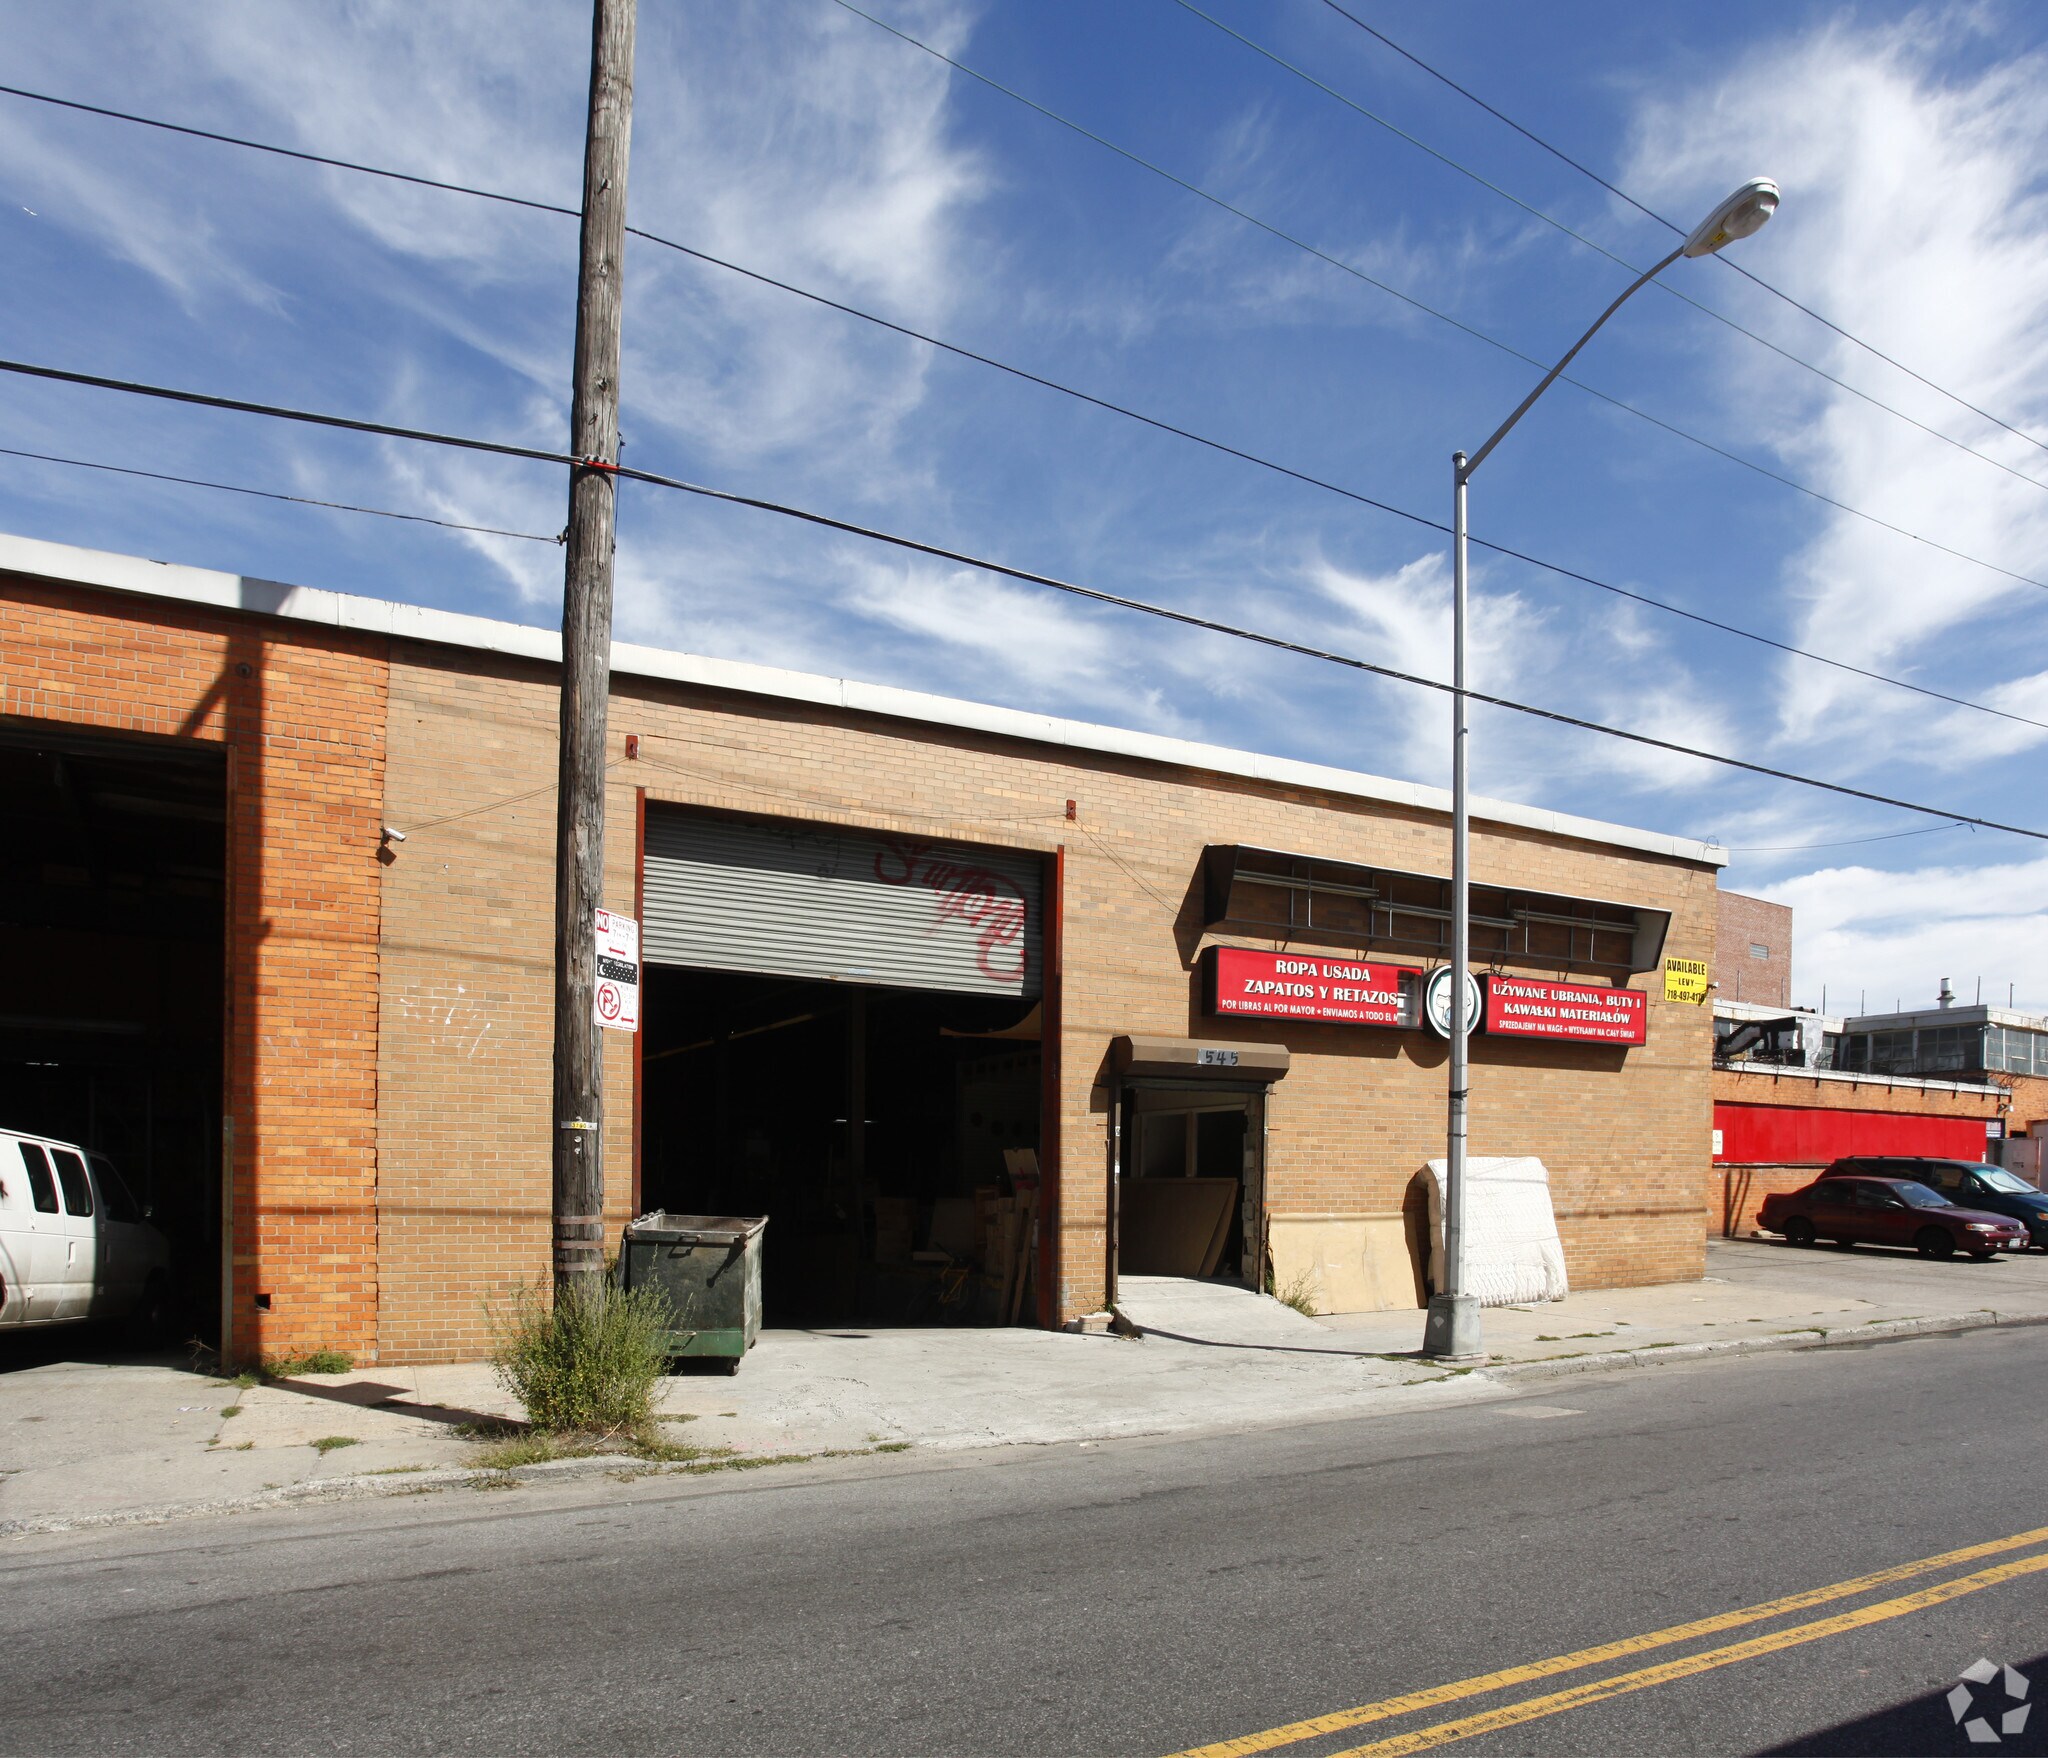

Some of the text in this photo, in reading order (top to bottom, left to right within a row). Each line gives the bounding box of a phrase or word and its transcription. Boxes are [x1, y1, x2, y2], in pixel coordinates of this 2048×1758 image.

[597, 912, 609, 931] NO
[1276, 959, 1372, 982] ROPA USADA
[1667, 959, 1706, 976] AVAILABLE
[1678, 977, 1695, 987] LEVY
[1243, 979, 1398, 1006] ZAPATOS Y RETAZOS
[1492, 980, 1641, 1009] UŻYWANE UBRANIA, BUTY I
[1667, 989, 1706, 1003] 718-497-417
[1221, 999, 1237, 1010] POR
[1238, 1000, 1262, 1012] LIBRAS
[1263, 1002, 1272, 1013] AL
[1273, 1003, 1288, 1014] POR
[1289, 1005, 1316, 1016] MAYOR
[1322, 1007, 1358, 1019] ENVIAMOS
[1359, 1010, 1365, 1020] A
[1365, 1011, 1384, 1021] TODO
[1385, 1013, 1392, 1022] EL
[1503, 1002, 1631, 1025] KAWAŁKI MATERIAŁÓW
[1498, 1019, 1537, 1031] SPRZEDAJEMY
[1537, 1022, 1546, 1032] NA
[1597, 1028, 1605, 1037] NA
[1205, 1050, 1239, 1066] 545
